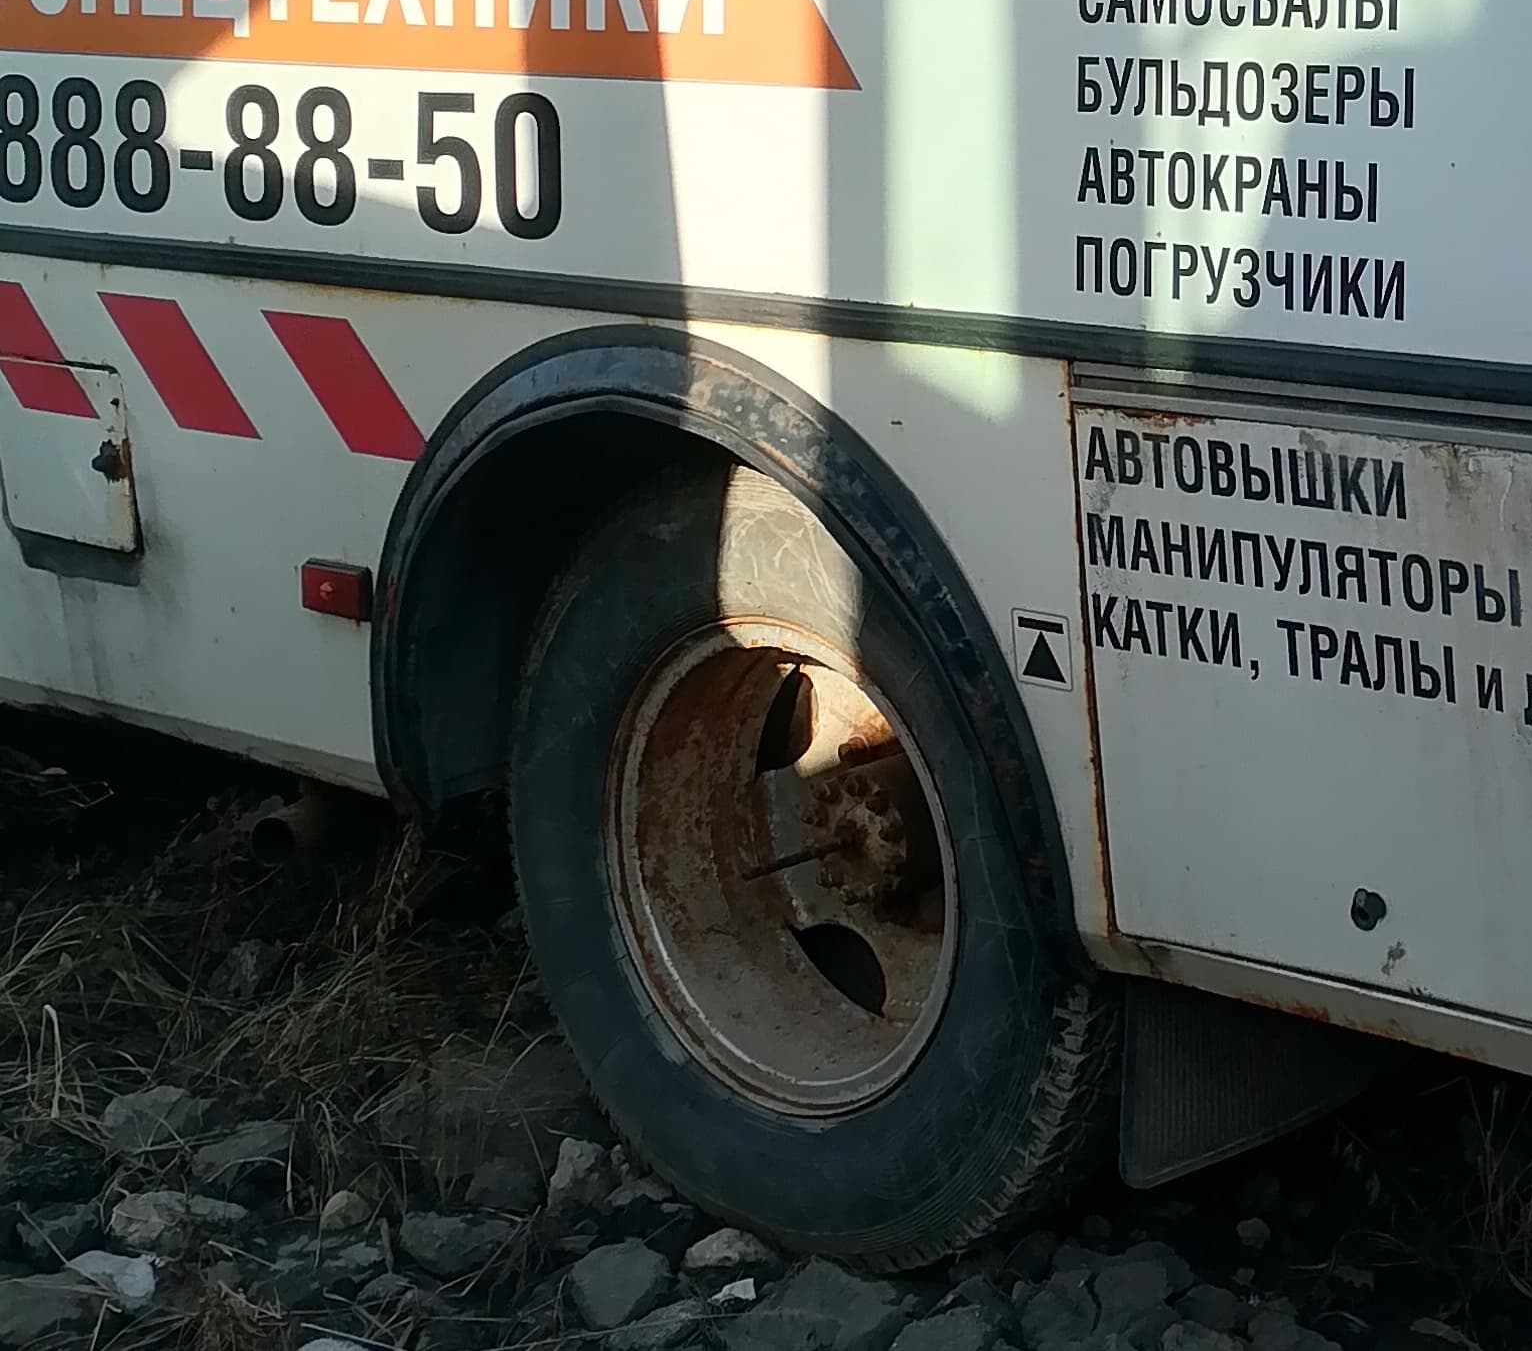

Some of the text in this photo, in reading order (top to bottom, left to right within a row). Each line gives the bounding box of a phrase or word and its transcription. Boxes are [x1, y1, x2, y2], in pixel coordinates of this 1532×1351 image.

[1076, 56, 1416, 129] БУЛЬДОЗЕРЫ
[0, 74, 563, 241] 888-88-50
[1076, 147, 1378, 223] АВТОКРАНЫ
[1075, 235, 1406, 322] ПОГРУЗЧИКИ
[1085, 425, 1408, 521] АВТОВЫШКИ
[1086, 512, 1523, 627] МАНИПУЛЯТОРЫ
[1091, 593, 1261, 681] КАТКИ,
[1276, 619, 1457, 704] ТРАЛЫ
[1475, 665, 1505, 713] и
